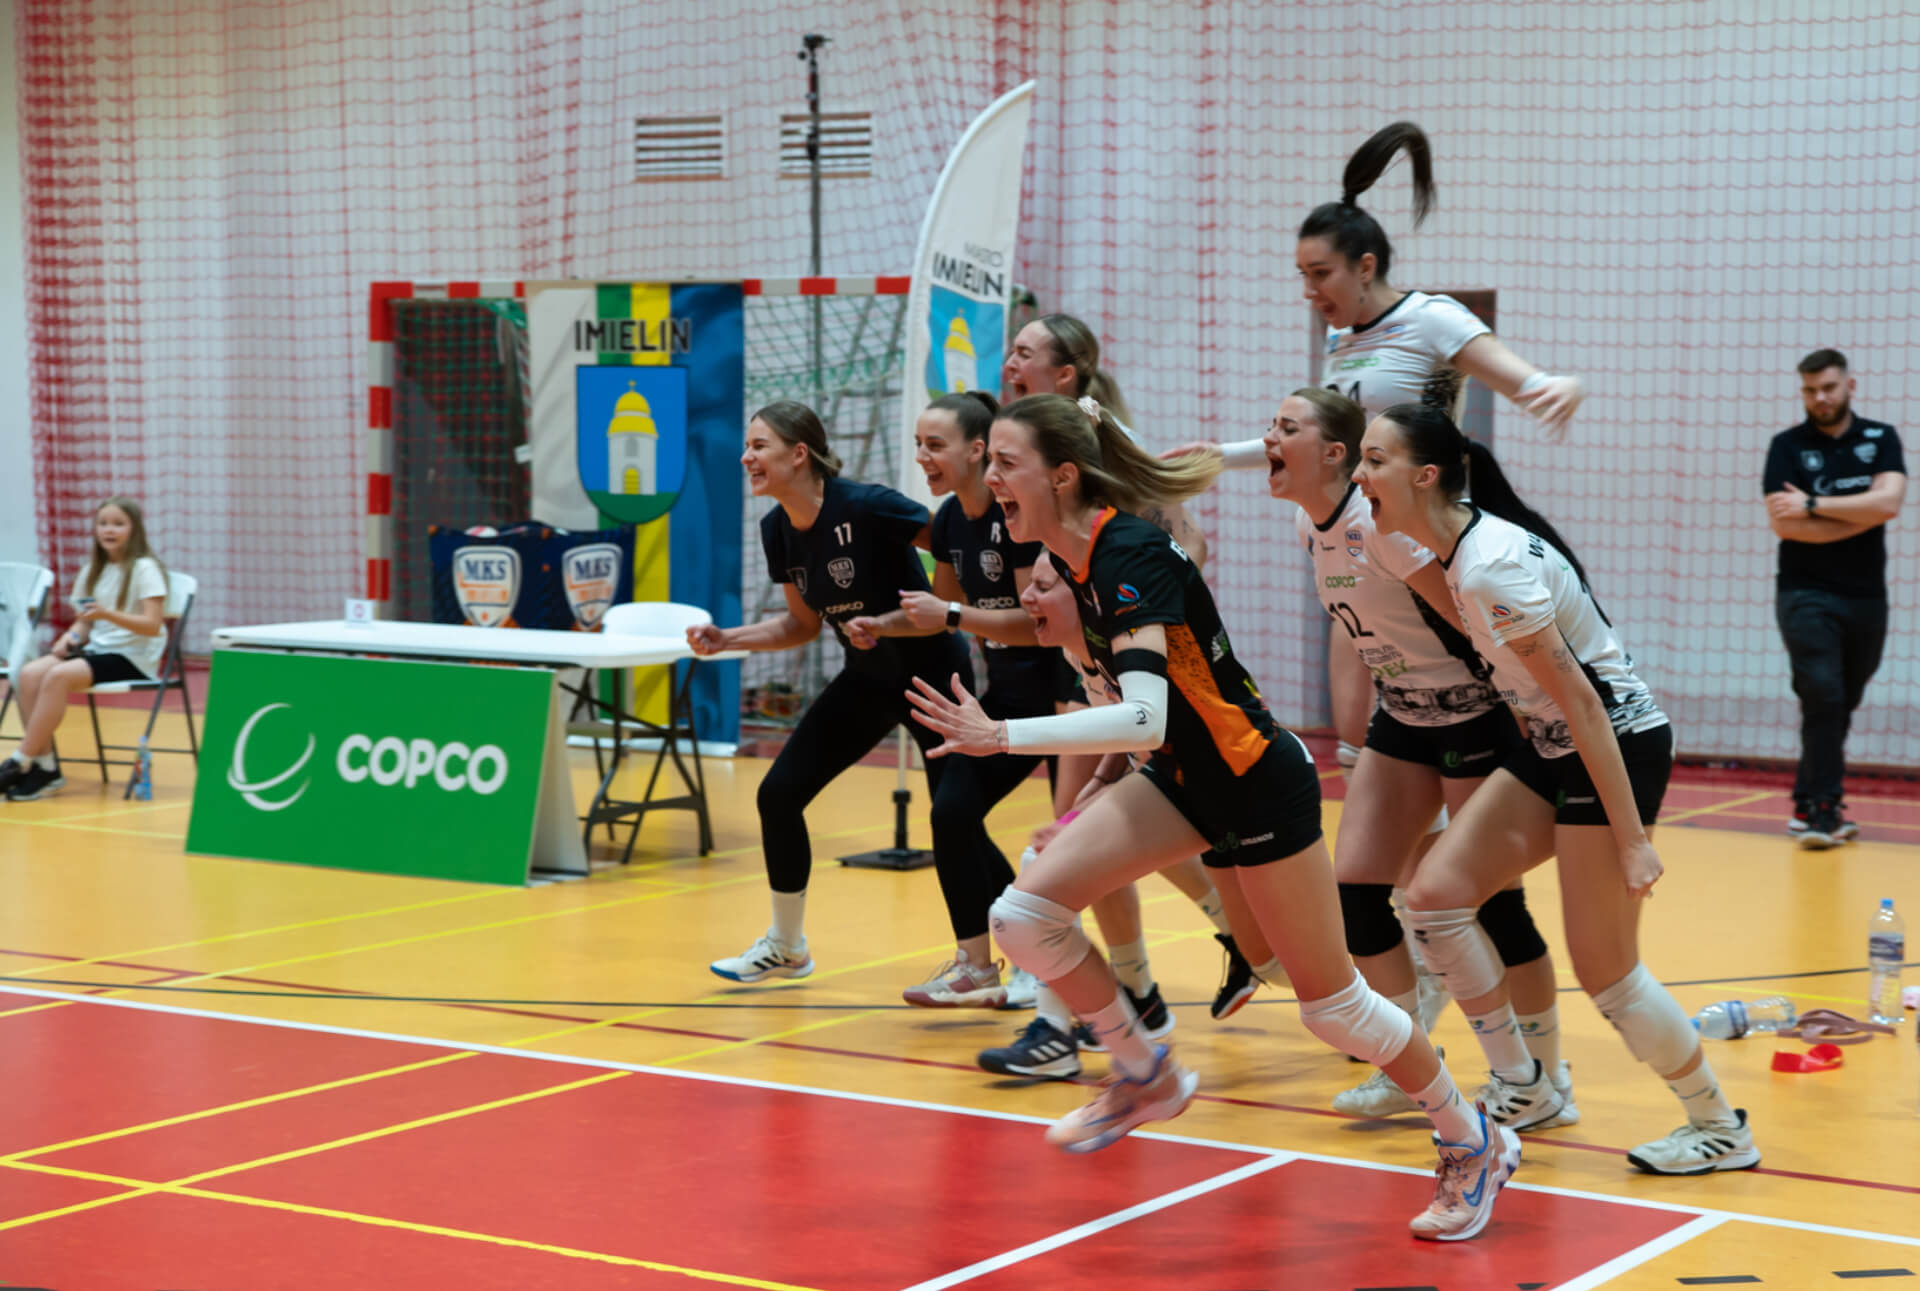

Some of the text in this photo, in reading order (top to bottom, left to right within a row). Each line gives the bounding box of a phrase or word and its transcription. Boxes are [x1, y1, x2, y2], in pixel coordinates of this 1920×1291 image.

[933, 252, 1004, 296] IMIELIN
[575, 320, 689, 351] IMIELIN
[834, 522, 852, 546] 17
[464, 559, 507, 581] MKS
[575, 556, 612, 581] MKS
[1329, 603, 1374, 638] 12
[336, 733, 509, 795] COPCO
